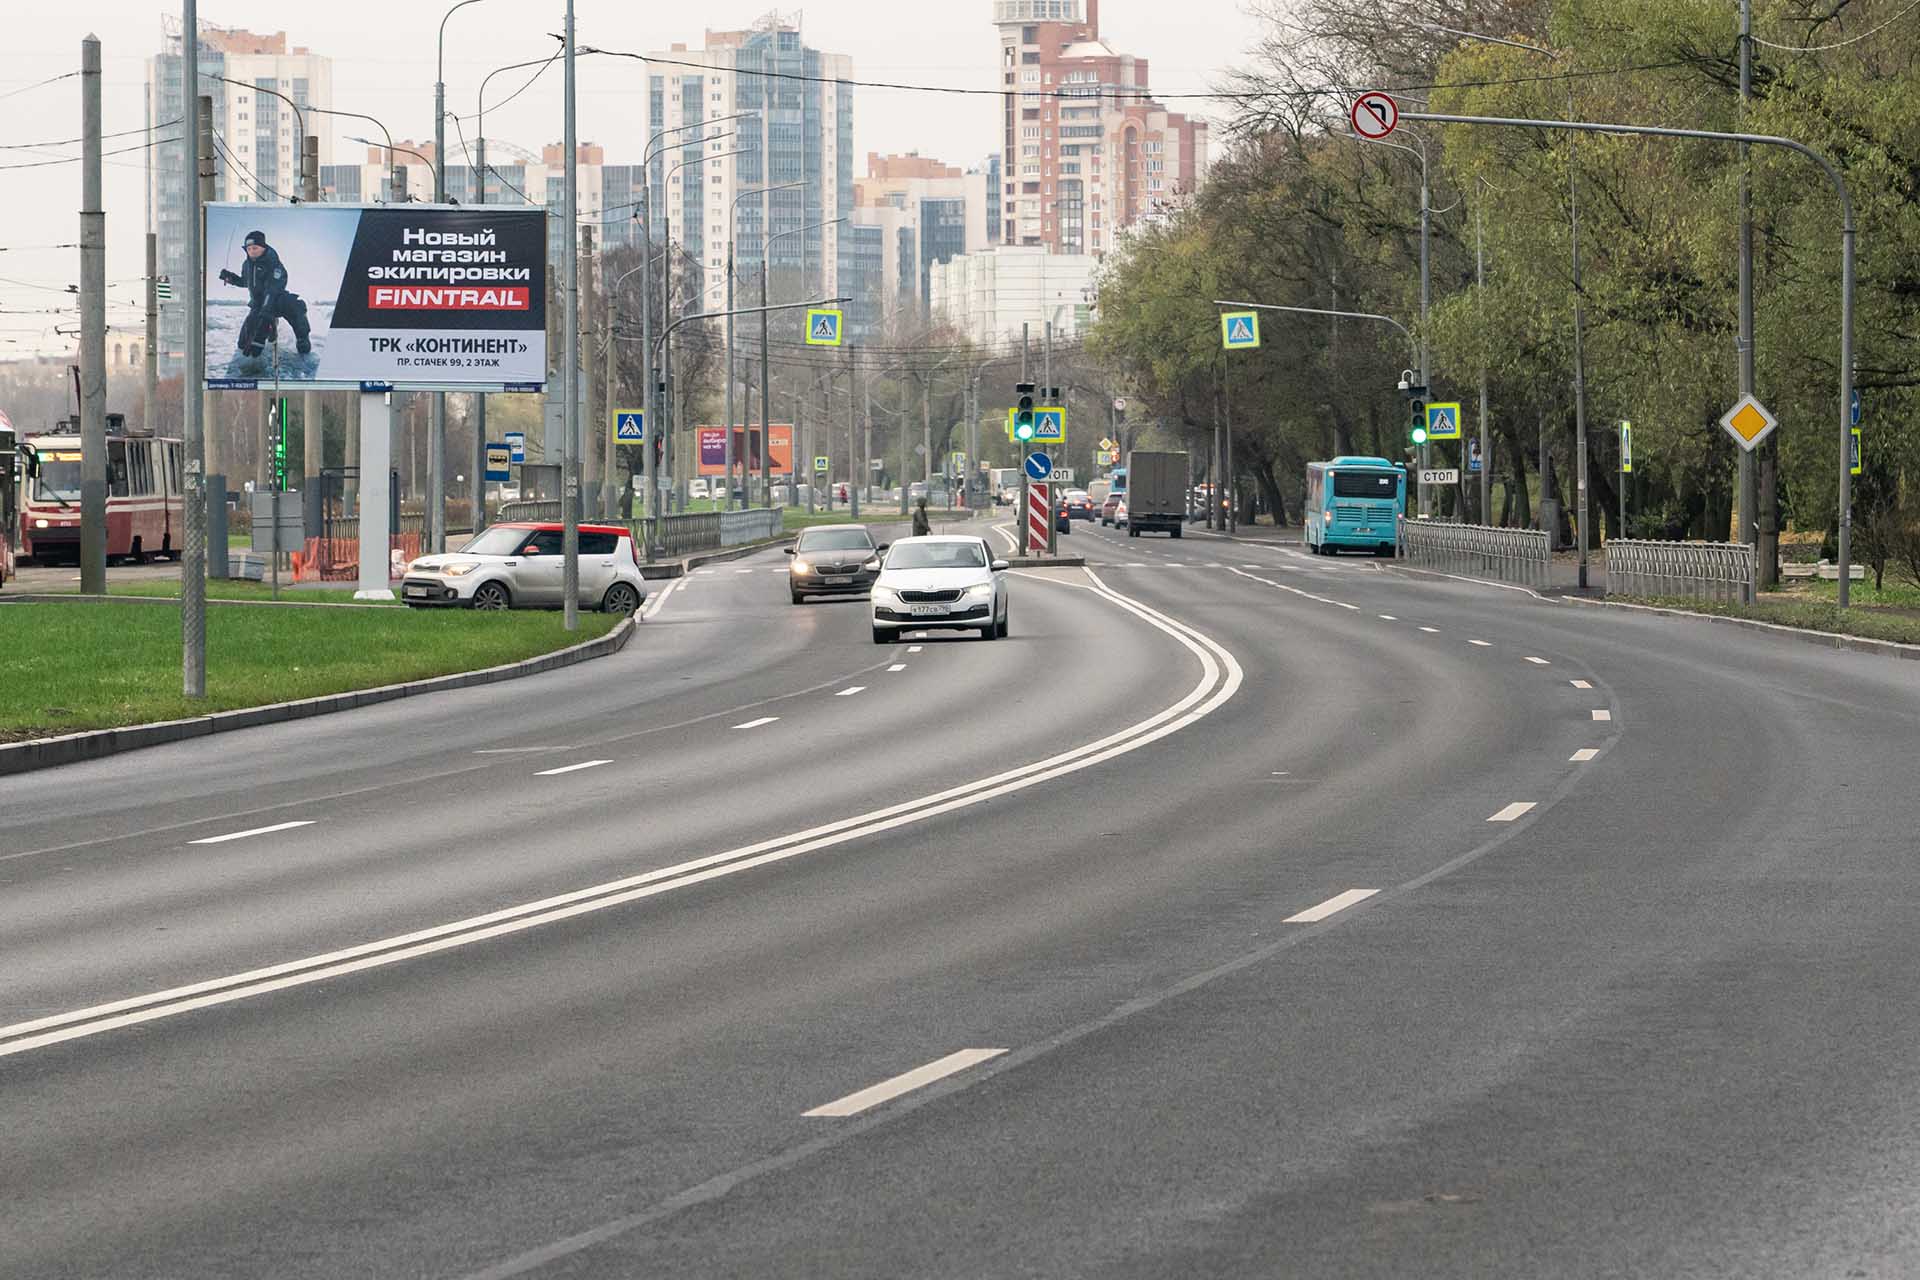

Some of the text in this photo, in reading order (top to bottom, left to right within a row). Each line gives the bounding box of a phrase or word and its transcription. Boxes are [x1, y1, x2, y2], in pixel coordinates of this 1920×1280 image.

[403, 228, 496, 246] Новый
[392, 249, 506, 263] магазин
[368, 266, 530, 284] экипировки
[375, 289, 522, 307] FINNTRAIL
[370, 337, 528, 354] ТРК «КОНТИНЕНТ»
[397, 357, 500, 368] ПР. СТАЧЕК 99, 2 ЭТАЖ
[1424, 471, 1453, 481] СТОП
